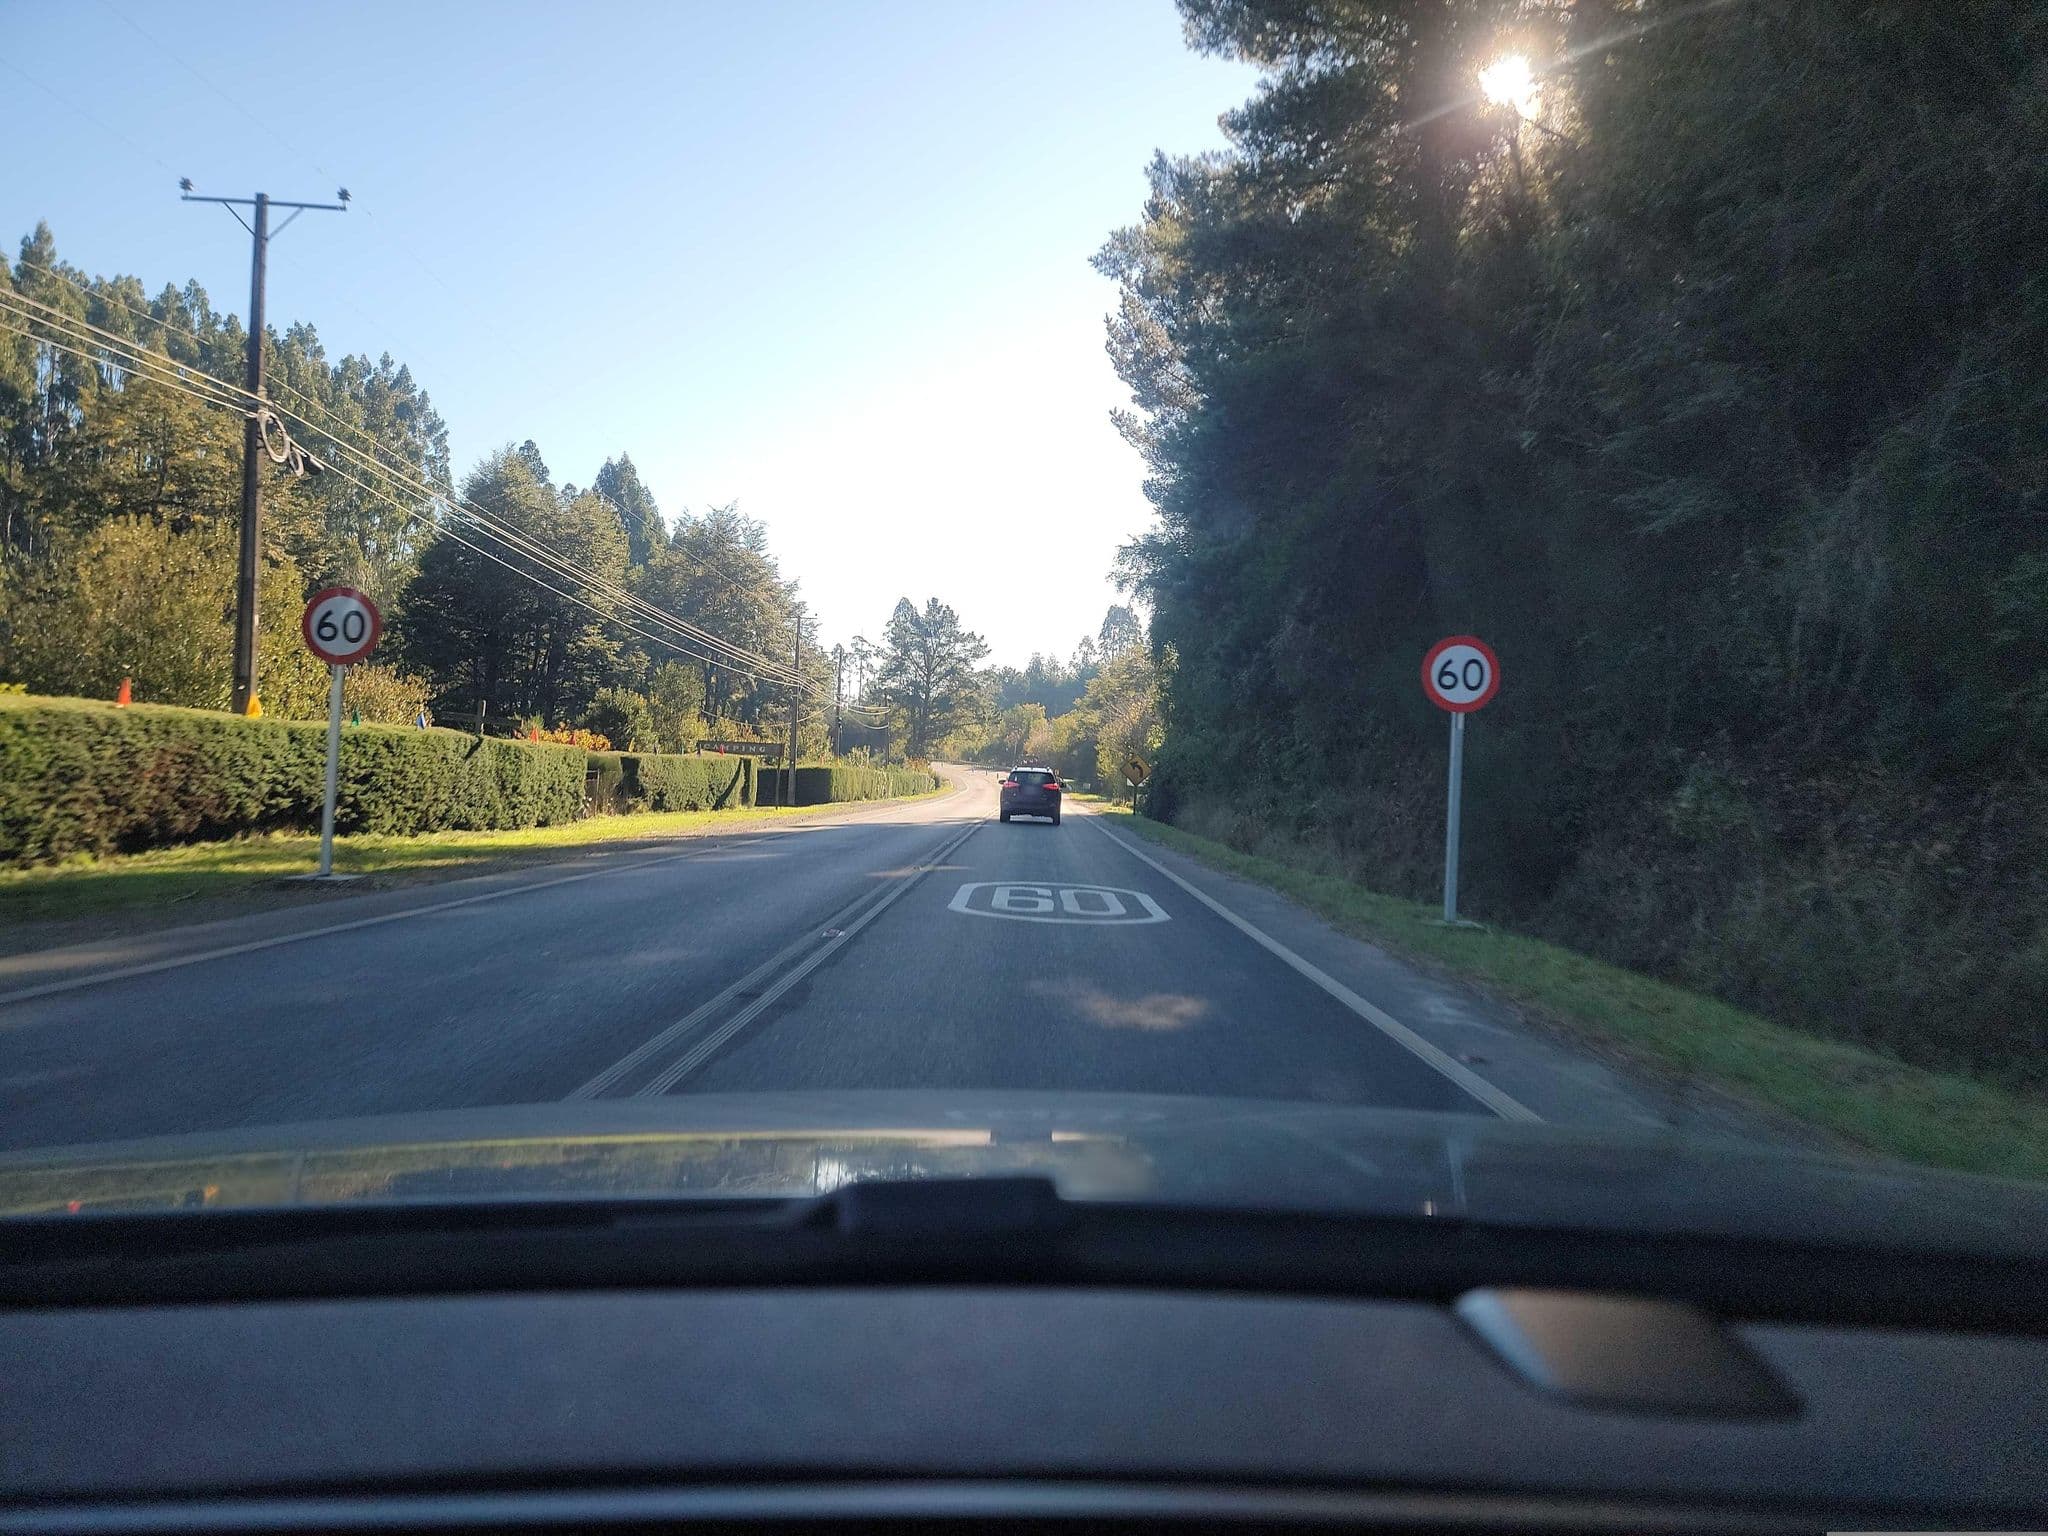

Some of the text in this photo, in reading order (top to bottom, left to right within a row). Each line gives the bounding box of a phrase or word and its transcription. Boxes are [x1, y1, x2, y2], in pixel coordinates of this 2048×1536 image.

[317, 610, 364, 643] 60
[1438, 659, 1483, 691] 60
[992, 886, 1126, 916] 60
